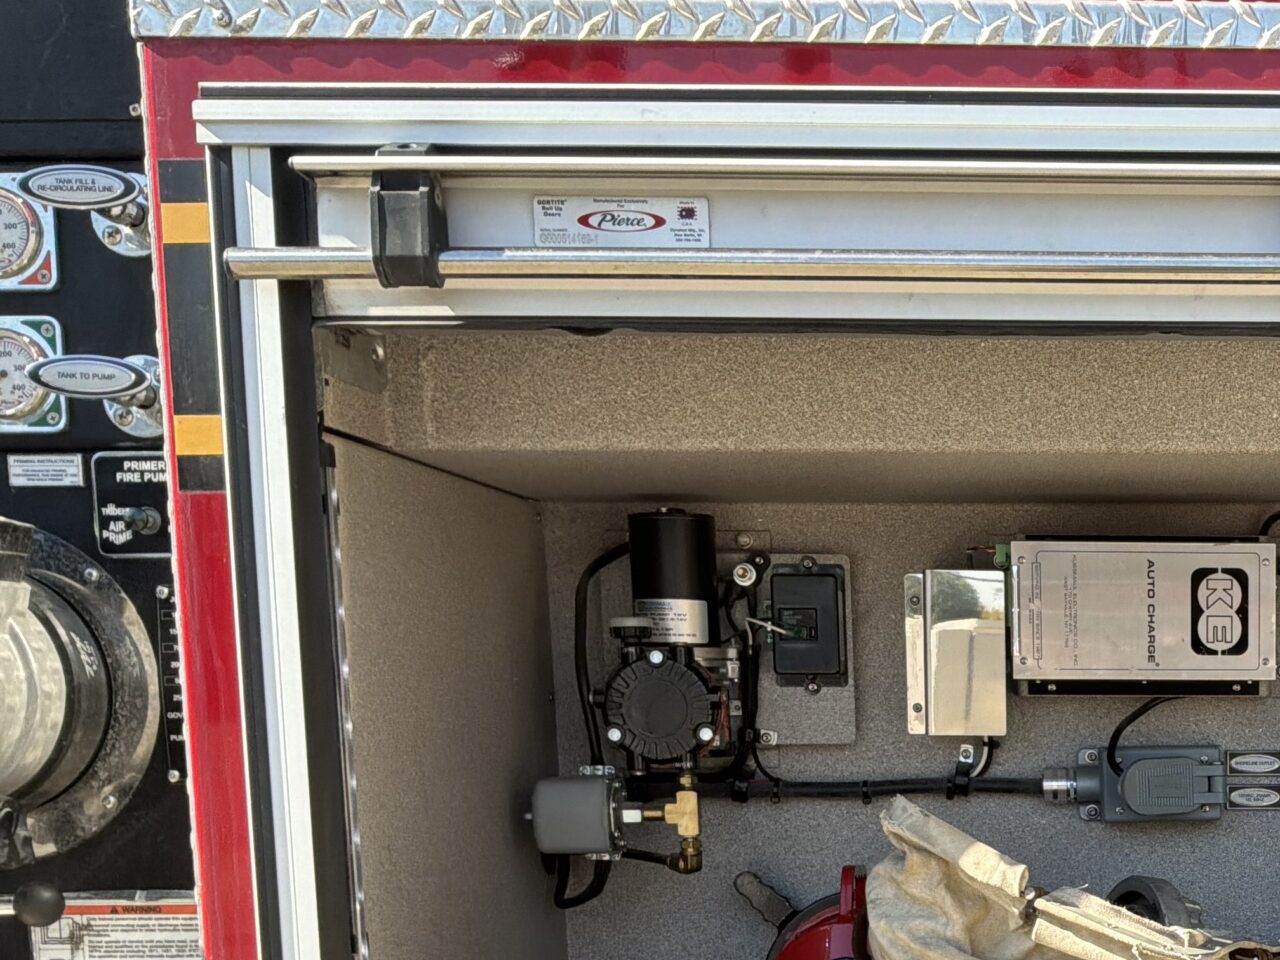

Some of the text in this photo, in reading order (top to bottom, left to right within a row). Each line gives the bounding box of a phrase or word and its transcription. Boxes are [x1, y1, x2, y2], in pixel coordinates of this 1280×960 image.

[598, 211, 645, 228] Pierce
[4, 222, 18, 230] 300
[57, 371, 115, 381] TANK TO PUMP
[12, 383, 26, 391] 400
[123, 460, 166, 471] PRIMER
[116, 472, 168, 483] FIRE PUM
[109, 520, 126, 533] AIR
[102, 529, 133, 546] PRIME
[1147, 558, 1156, 664] AUTO CHARGE
[121, 906, 162, 914] WARNING
